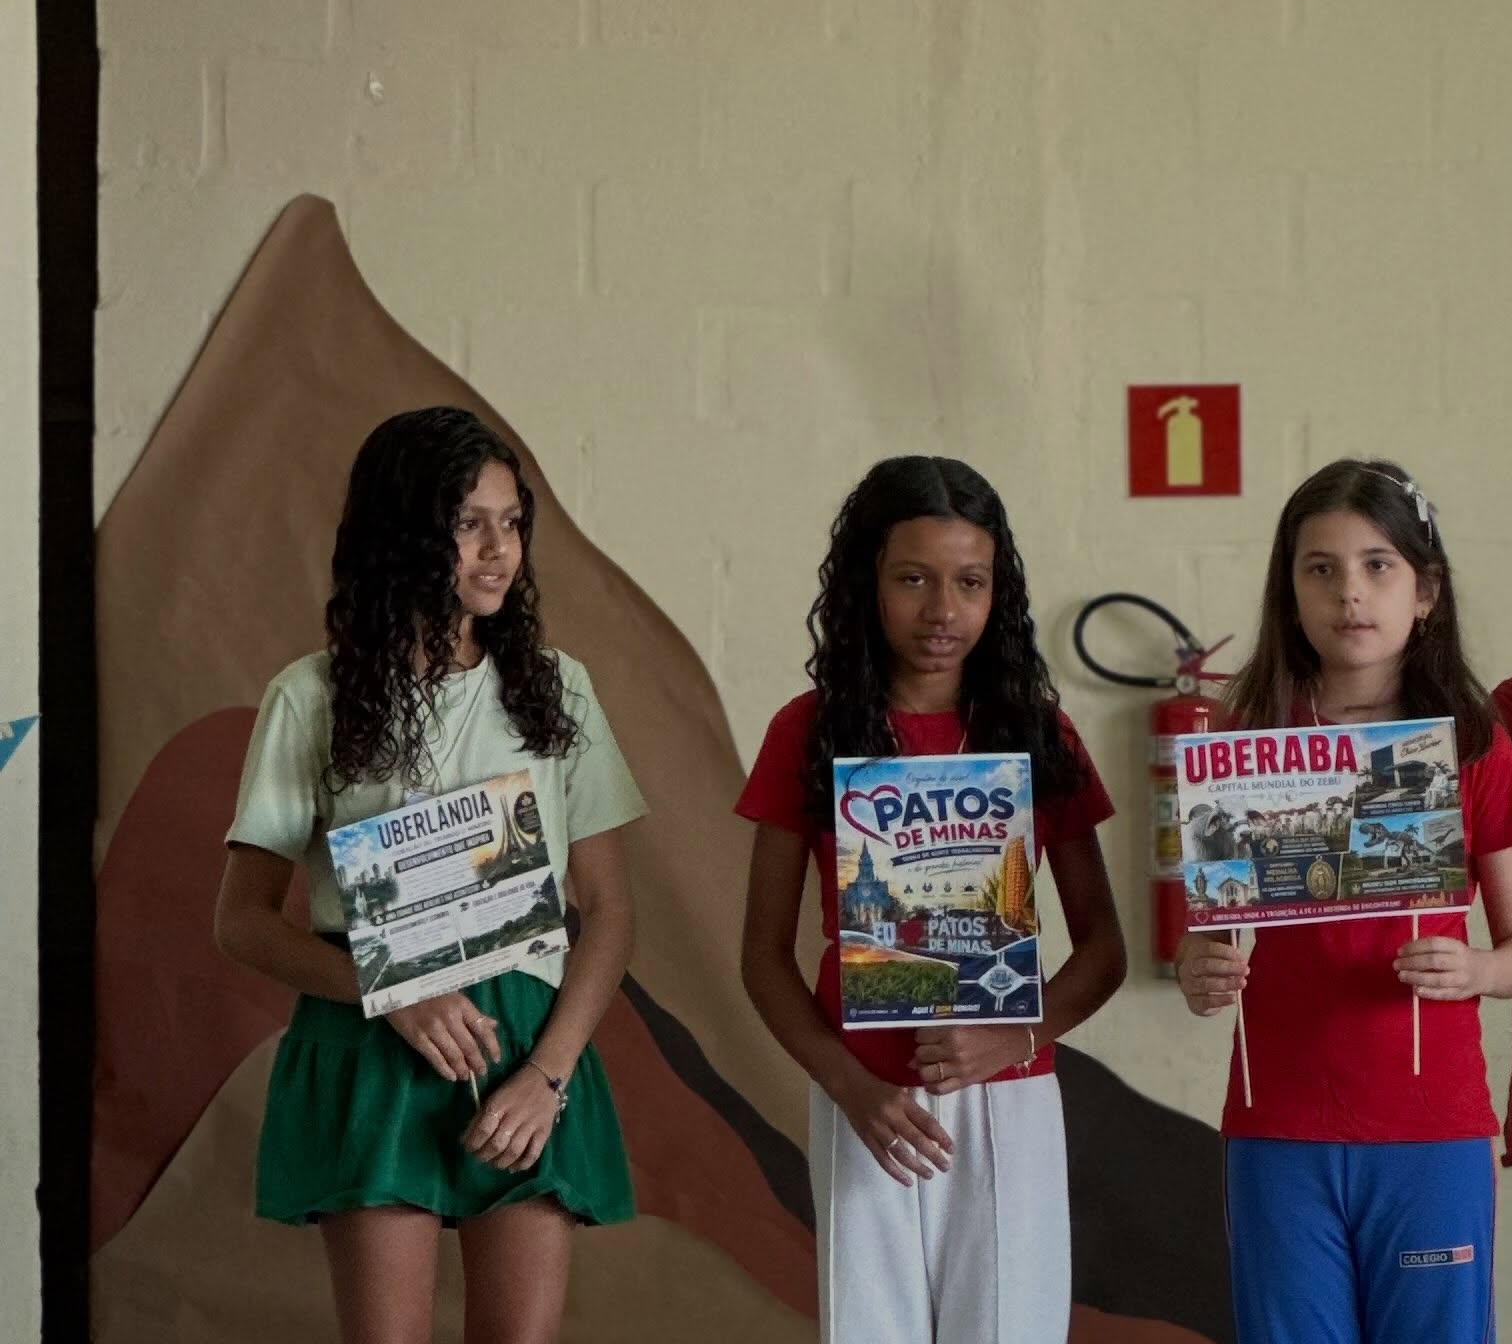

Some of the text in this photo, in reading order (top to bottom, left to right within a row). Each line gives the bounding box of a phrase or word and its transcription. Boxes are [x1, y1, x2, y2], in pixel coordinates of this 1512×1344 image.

[1184, 734, 1358, 784] UBERABA
[1208, 782, 1249, 793] CAPITAL
[1251, 779, 1297, 790] MUNDIAL
[377, 790, 493, 849] UBERLÂNDIA
[873, 786, 1015, 832] PATOS
[894, 822, 1009, 849] DE MINAS
[872, 916, 987, 947] EU PATOS
[928, 938, 992, 954] DE MINAS
